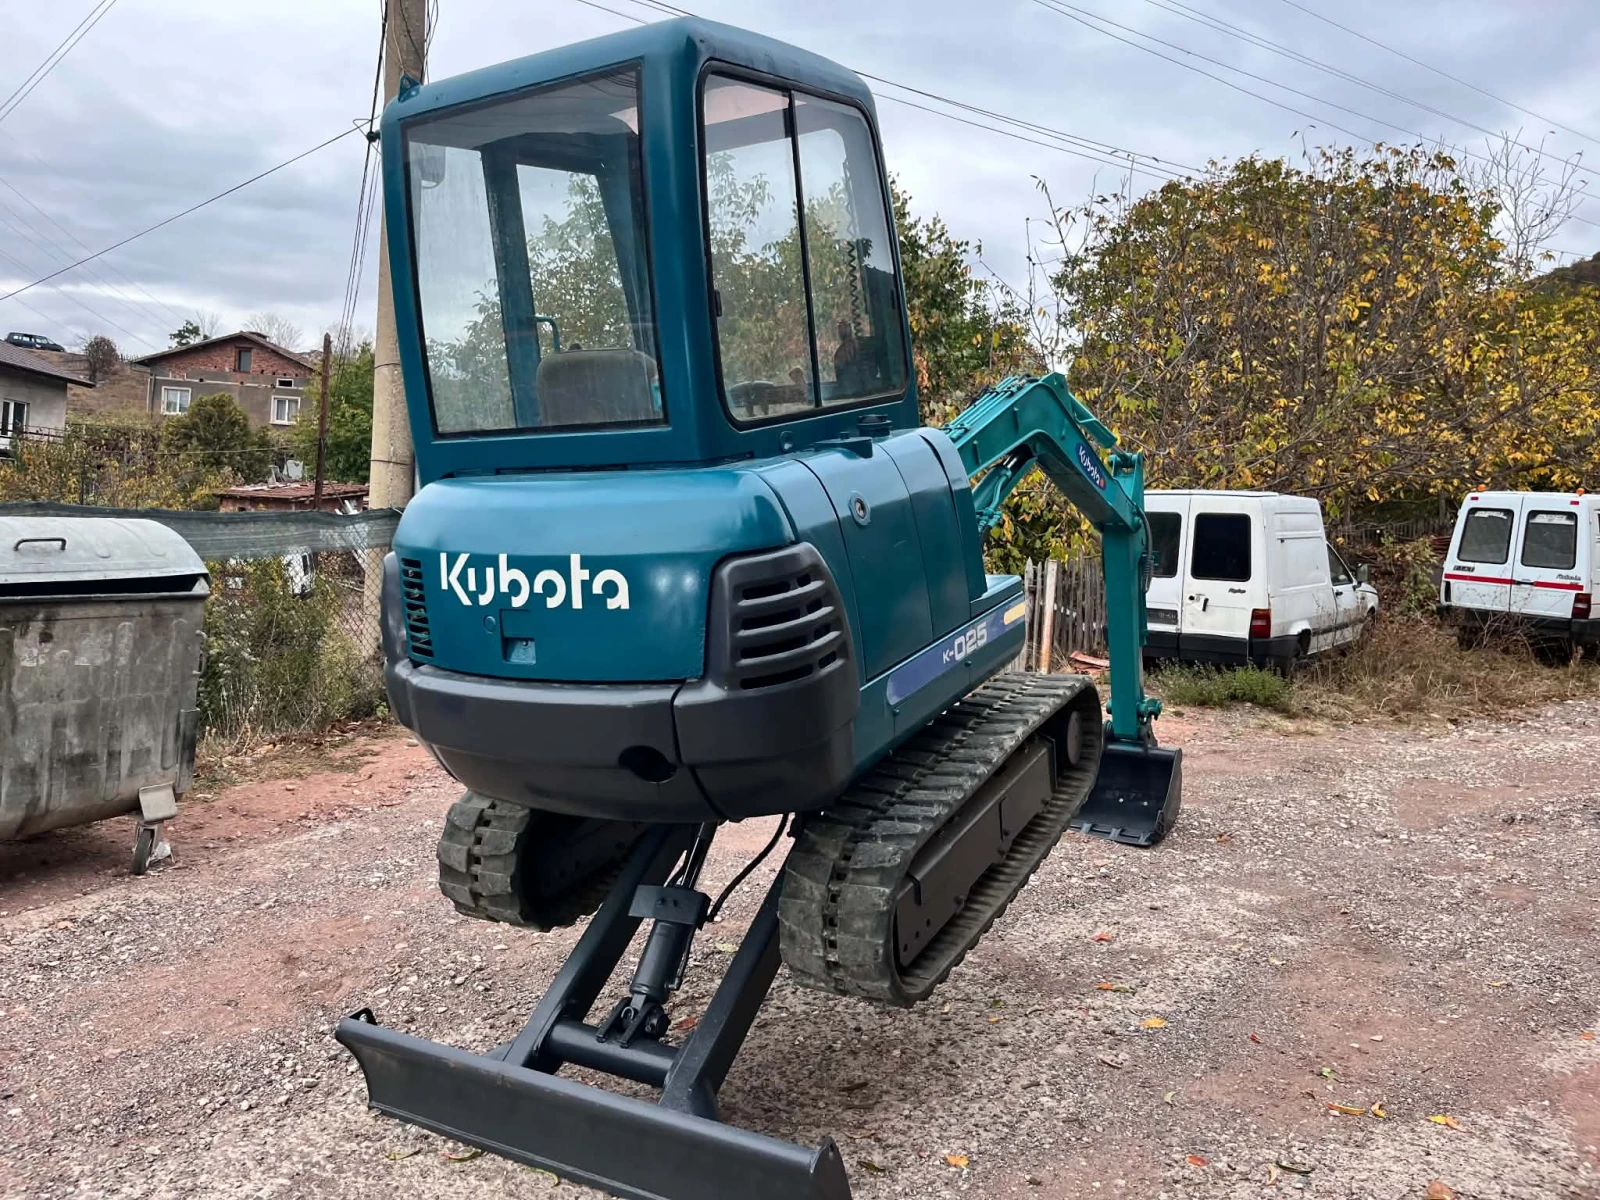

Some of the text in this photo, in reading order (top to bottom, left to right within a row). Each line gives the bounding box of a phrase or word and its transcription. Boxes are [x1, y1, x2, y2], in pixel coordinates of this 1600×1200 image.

[1079, 445, 1100, 485] Kubota
[440, 552, 630, 610] Kubota
[942, 621, 988, 664] K-025
